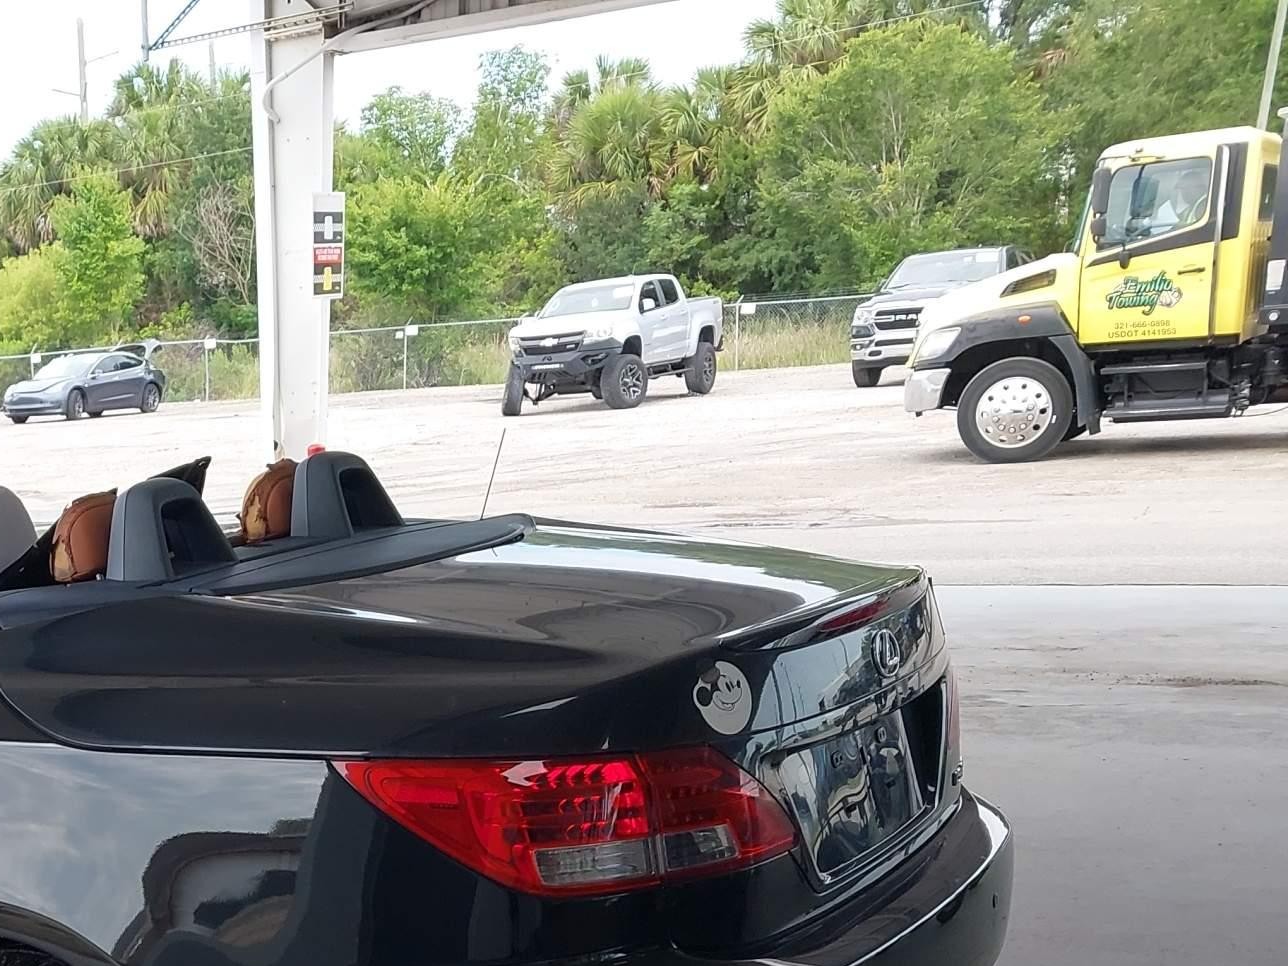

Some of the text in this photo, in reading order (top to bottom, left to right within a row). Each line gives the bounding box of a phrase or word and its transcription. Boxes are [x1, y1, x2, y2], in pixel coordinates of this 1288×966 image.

[1124, 271, 1173, 293] Emilio
[1106, 291, 1160, 316] Towing
[1108, 330, 1139, 338] USDOT
